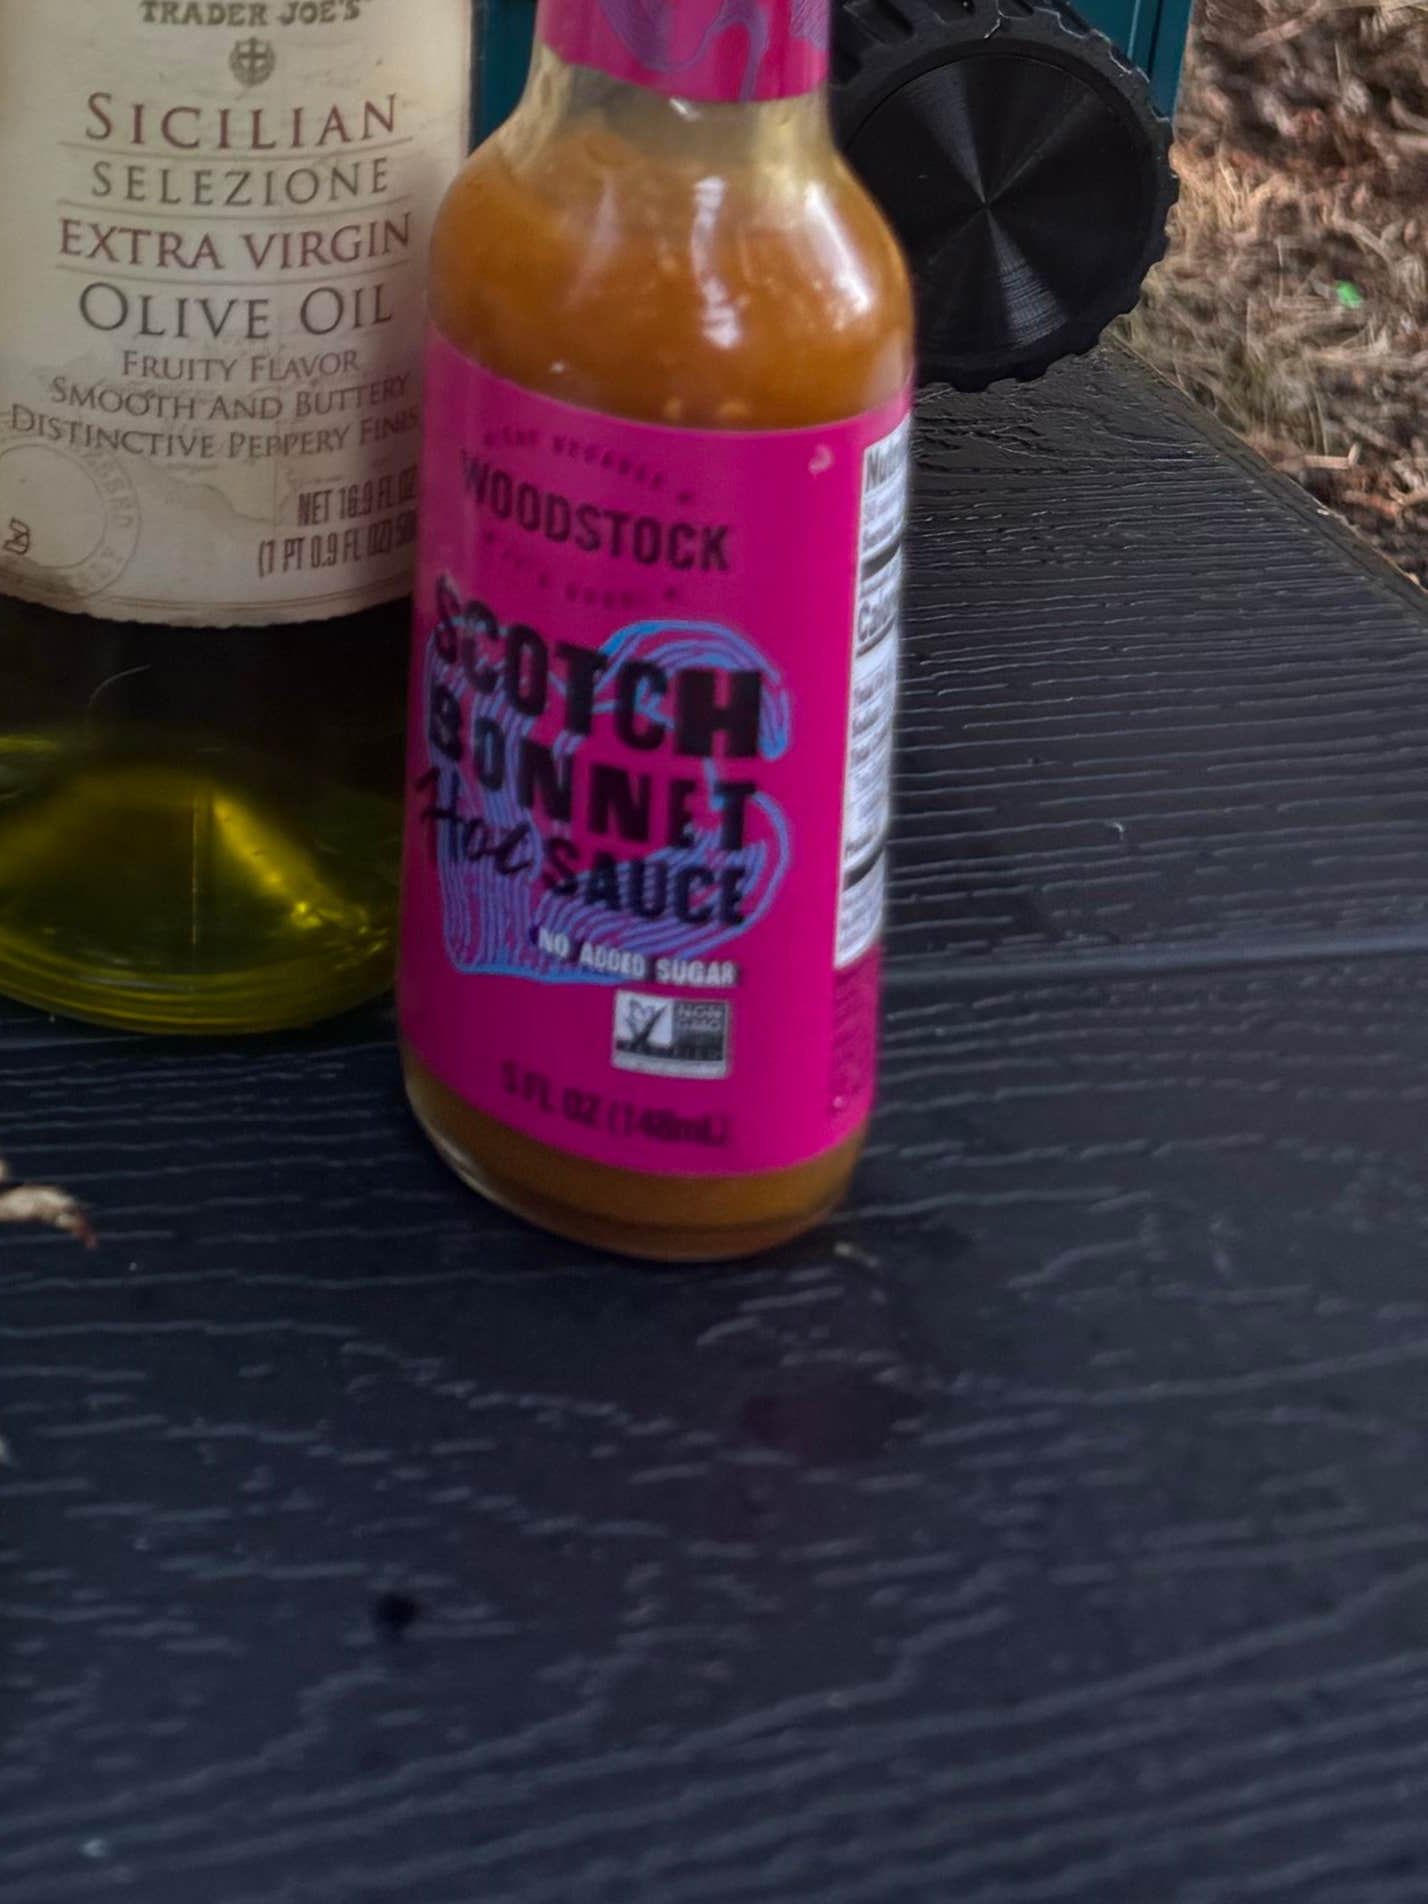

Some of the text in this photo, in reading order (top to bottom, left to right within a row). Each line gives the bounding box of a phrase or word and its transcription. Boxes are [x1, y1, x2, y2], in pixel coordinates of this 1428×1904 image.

[85, 92, 399, 150] SICILIAN
[90, 156, 390, 208] SELEZIONE
[58, 210, 414, 270] EXTRA VIRGIN
[79, 281, 394, 340] OLIVE OIL
[121, 348, 362, 384] FRUITY FLAVOR
[50, 372, 412, 420] SMOOTH AND BUTTERY
[11, 402, 216, 460] DISTINCTIVE
[227, 424, 352, 460] PEPPERY
[297, 489, 333, 527] NET
[376, 474, 394, 510] FL
[460, 447, 731, 573] WOODSTOCK
[258, 538, 277, 578] (1
[282, 535, 306, 572] PT
[310, 531, 339, 569] 0.9
[343, 528, 362, 564] FL
[434, 574, 764, 760] SCOTCH
[429, 685, 758, 852] BONNET
[414, 766, 534, 877] Hot
[544, 835, 749, 927] SAUCE
[538, 925, 739, 987] NO ADDED SUGAR
